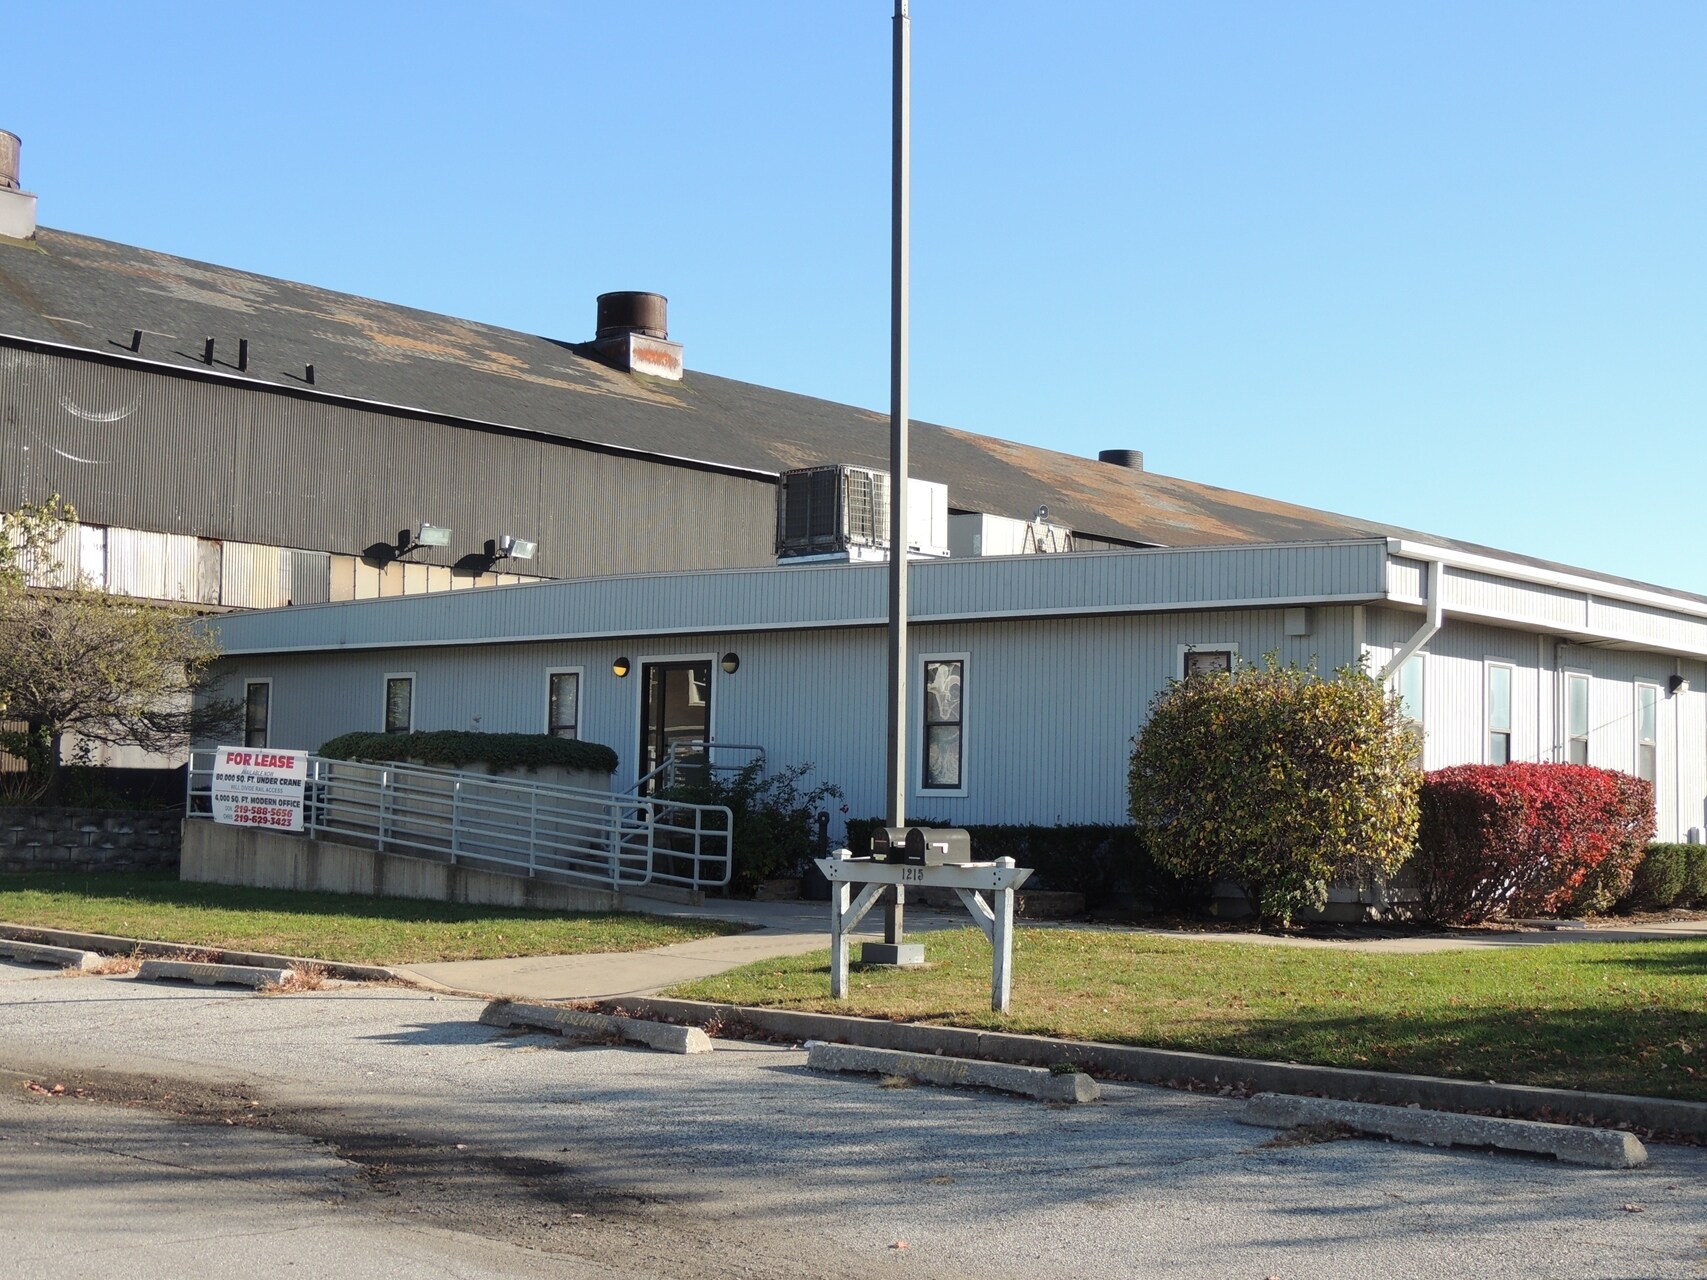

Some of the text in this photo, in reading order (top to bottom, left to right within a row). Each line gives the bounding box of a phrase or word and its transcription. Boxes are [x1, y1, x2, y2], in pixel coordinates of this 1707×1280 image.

[226, 752, 295, 769] FOR LEASE
[236, 775, 246, 783] SQ.
[256, 776, 278, 786] UNDER
[279, 778, 302, 787] CRANE
[231, 795, 240, 804] SQ.
[241, 796, 250, 804] FT.
[250, 797, 277, 806] MODERN
[278, 799, 301, 808] OFFICE
[234, 805, 293, 818] 219-588-5656
[234, 814, 293, 827] 219-629-3423
[901, 868, 924, 881] 1215
